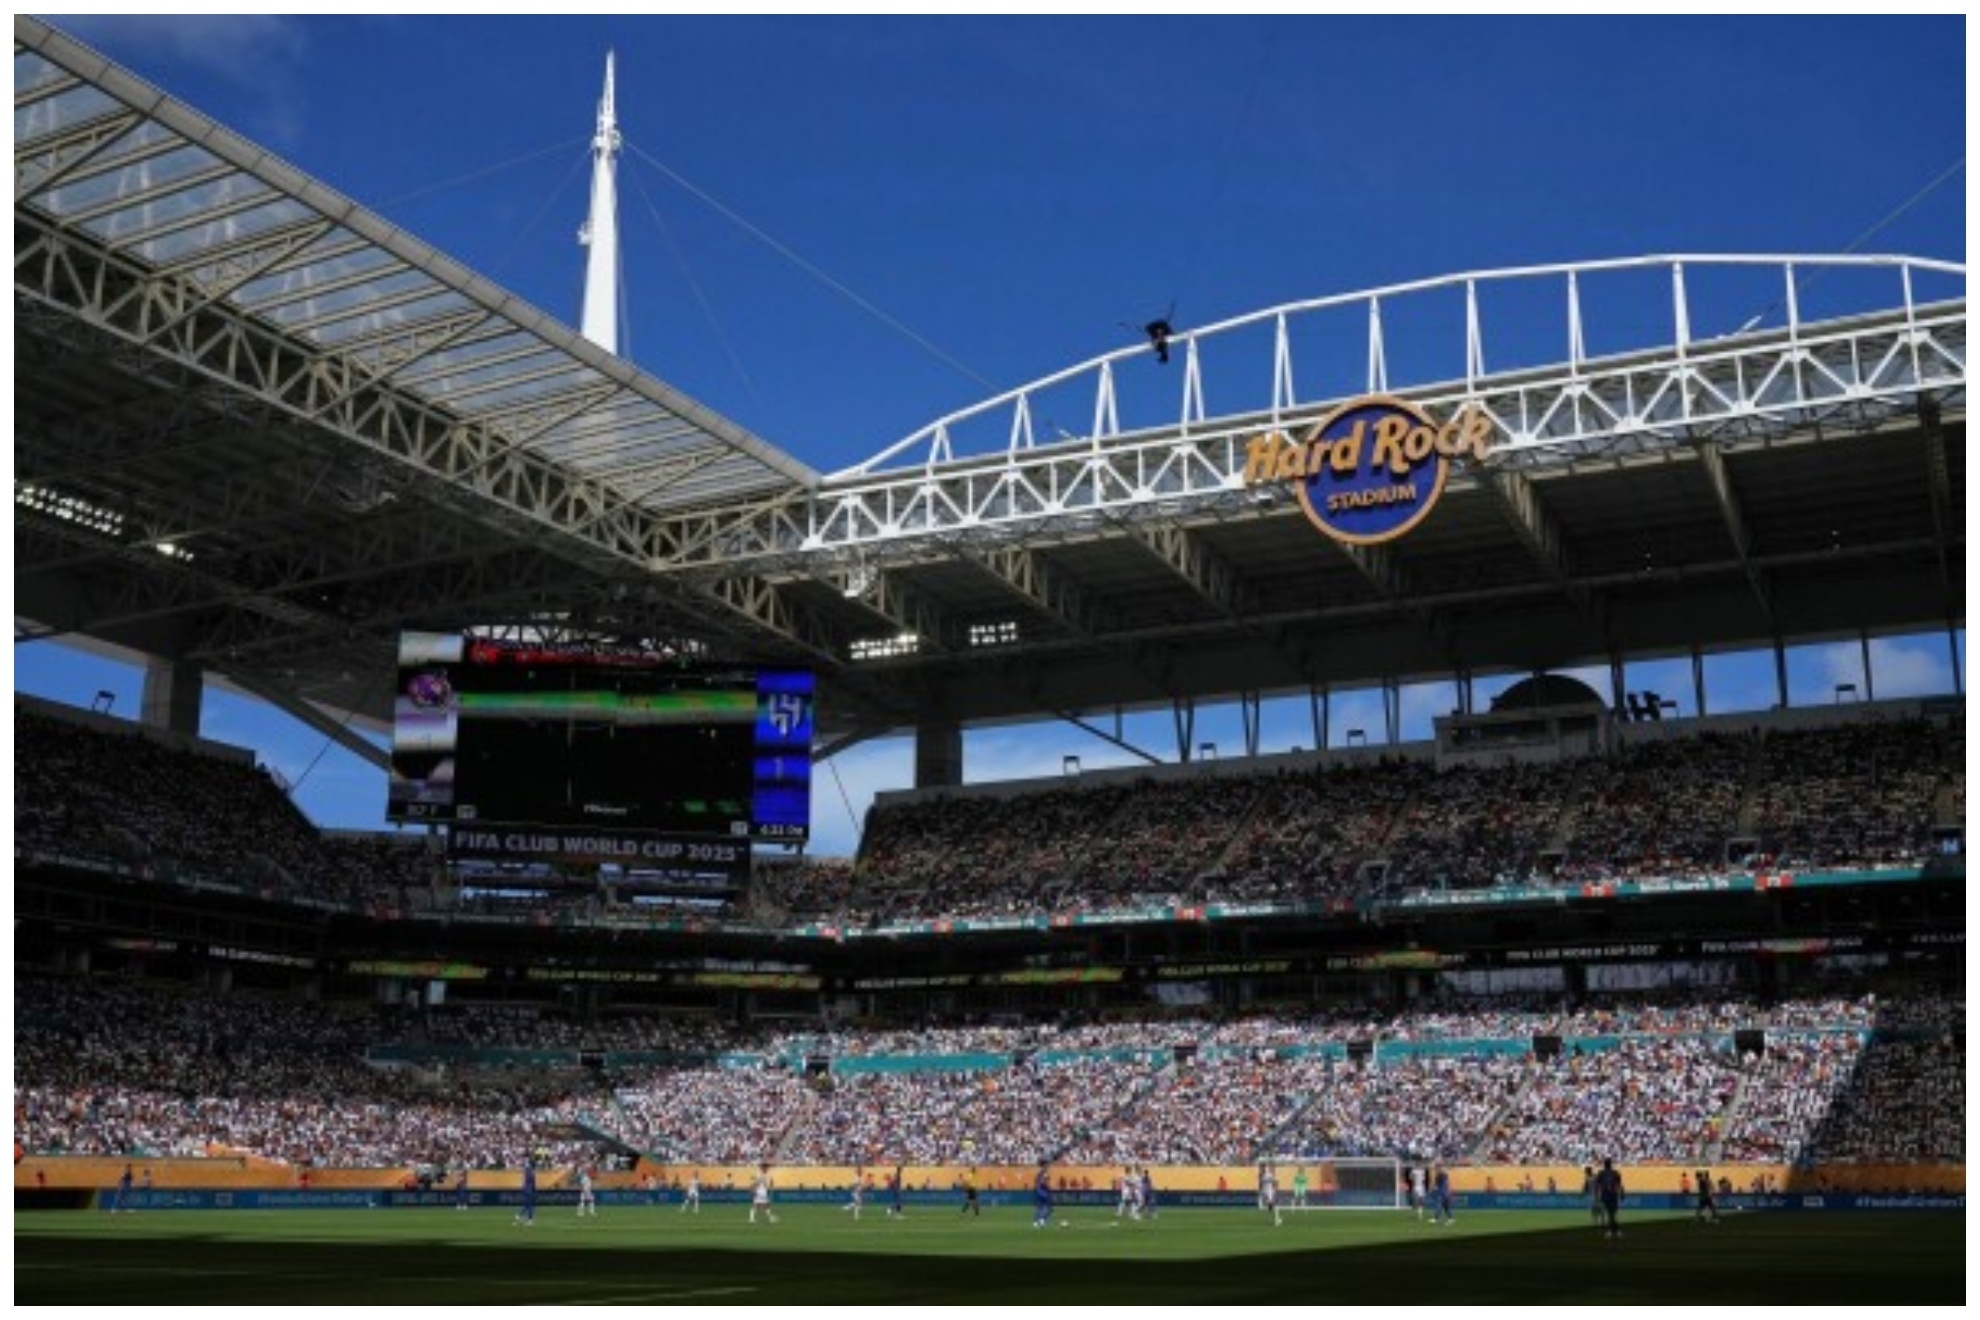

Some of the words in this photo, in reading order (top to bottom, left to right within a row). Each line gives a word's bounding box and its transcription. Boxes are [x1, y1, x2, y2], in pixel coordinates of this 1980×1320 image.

[1243, 420, 1366, 482] Hard
[1373, 408, 1491, 473] Rock
[1328, 485, 1416, 509] STADIUM
[455, 831, 500, 850] FIFA
[505, 833, 558, 854] CLUB
[563, 836, 637, 857] WORLD
[641, 840, 684, 859] CUP
